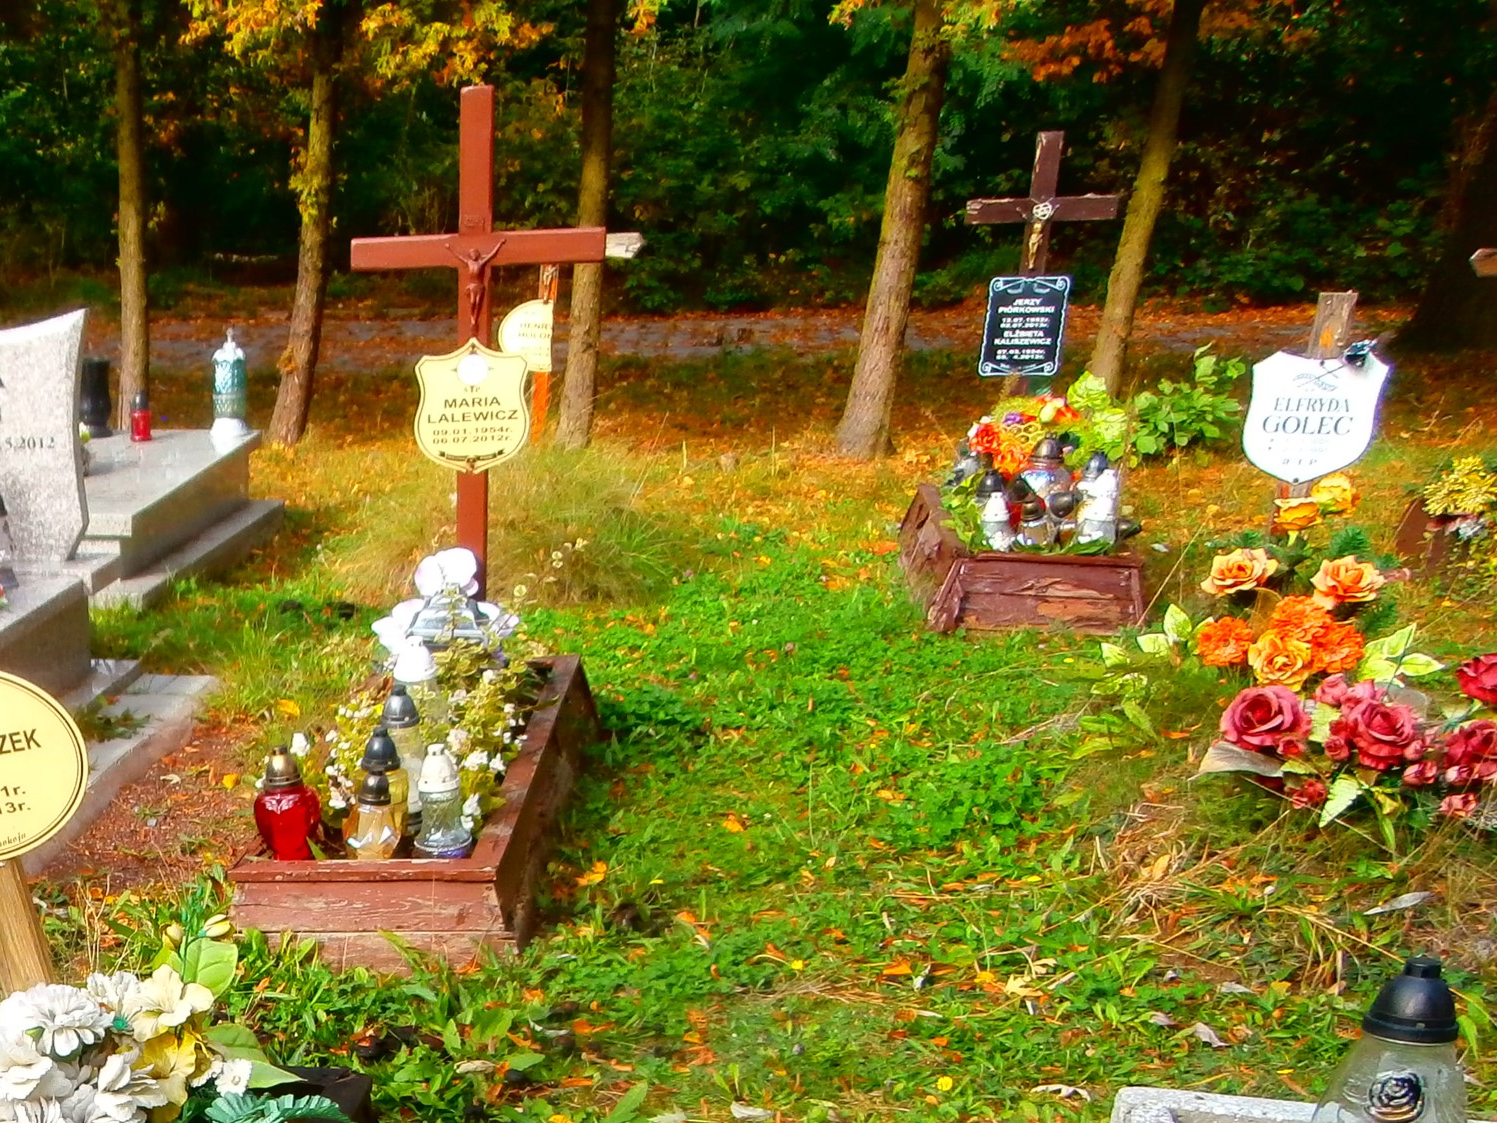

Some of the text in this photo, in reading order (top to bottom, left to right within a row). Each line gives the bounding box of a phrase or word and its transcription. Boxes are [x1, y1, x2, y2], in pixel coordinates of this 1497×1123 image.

[1012, 298, 1043, 306] JERZY
[998, 305, 1055, 313] PIÓRKOWSKI
[1003, 329, 1044, 338] ELŻBIETA
[994, 337, 1052, 345] KALISZEWICZ
[444, 396, 501, 409] MARIA
[1273, 397, 1350, 412] ELFRYDA
[427, 409, 518, 424] LALEWICZ
[1262, 414, 1354, 436] GOLEC
